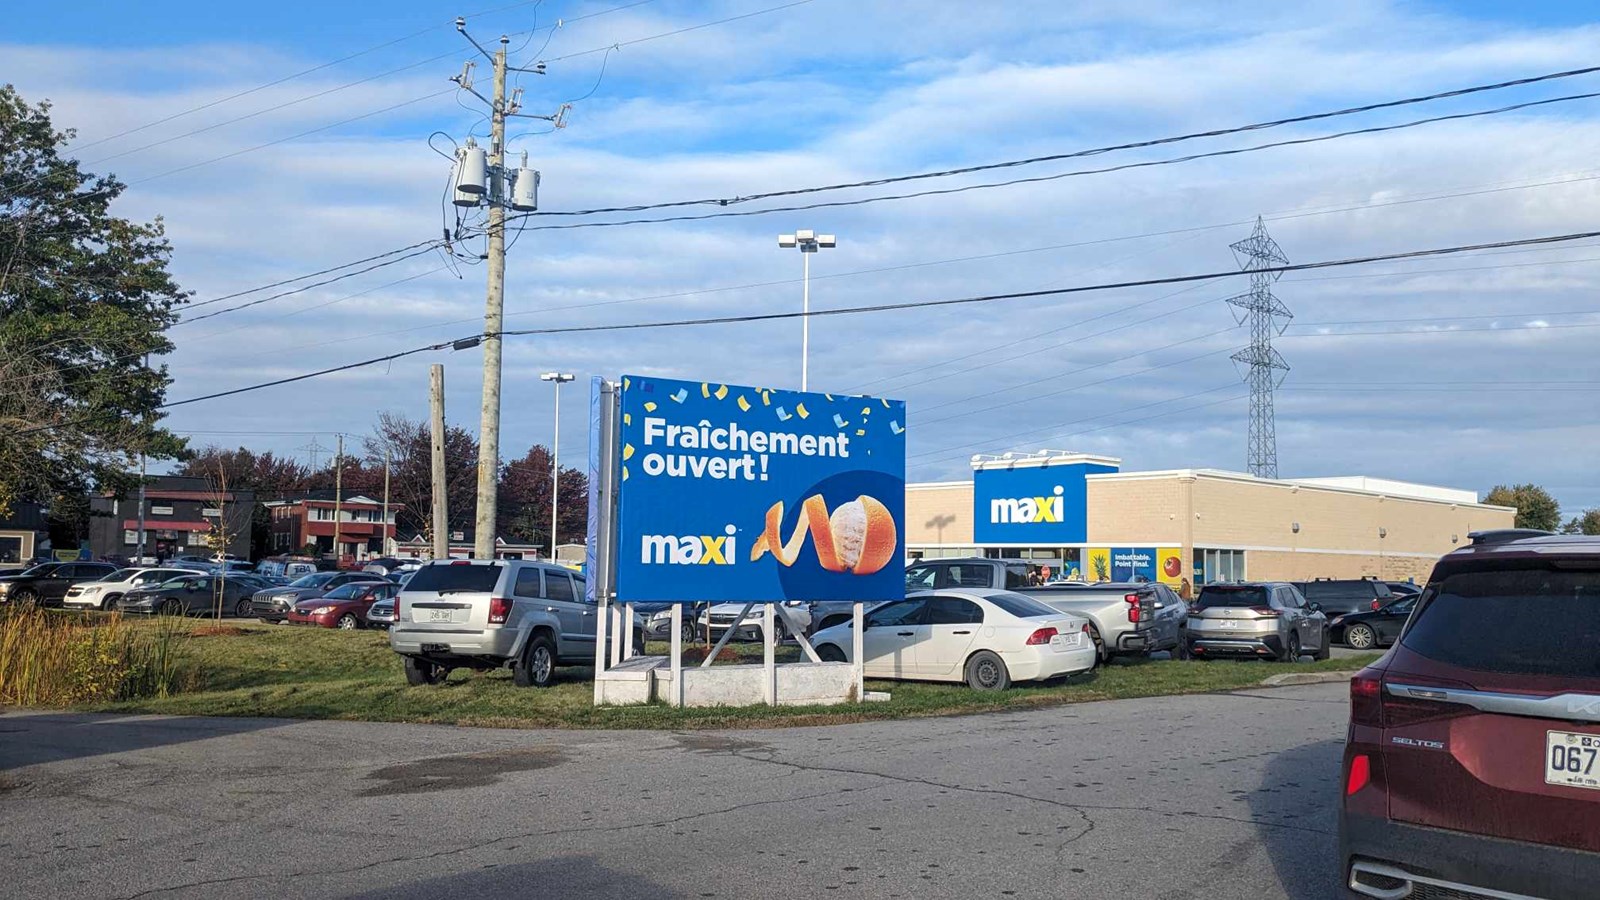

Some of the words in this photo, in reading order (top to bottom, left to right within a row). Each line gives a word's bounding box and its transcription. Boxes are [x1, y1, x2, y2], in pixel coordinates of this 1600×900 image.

[643, 416, 850, 458] Fraîchement
[990, 485, 1065, 523] maxi
[641, 524, 737, 565] maxi
[1114, 560, 1132, 568] Point
[1391, 736, 1445, 749] SELTOS
[1551, 744, 1598, 775] 067
